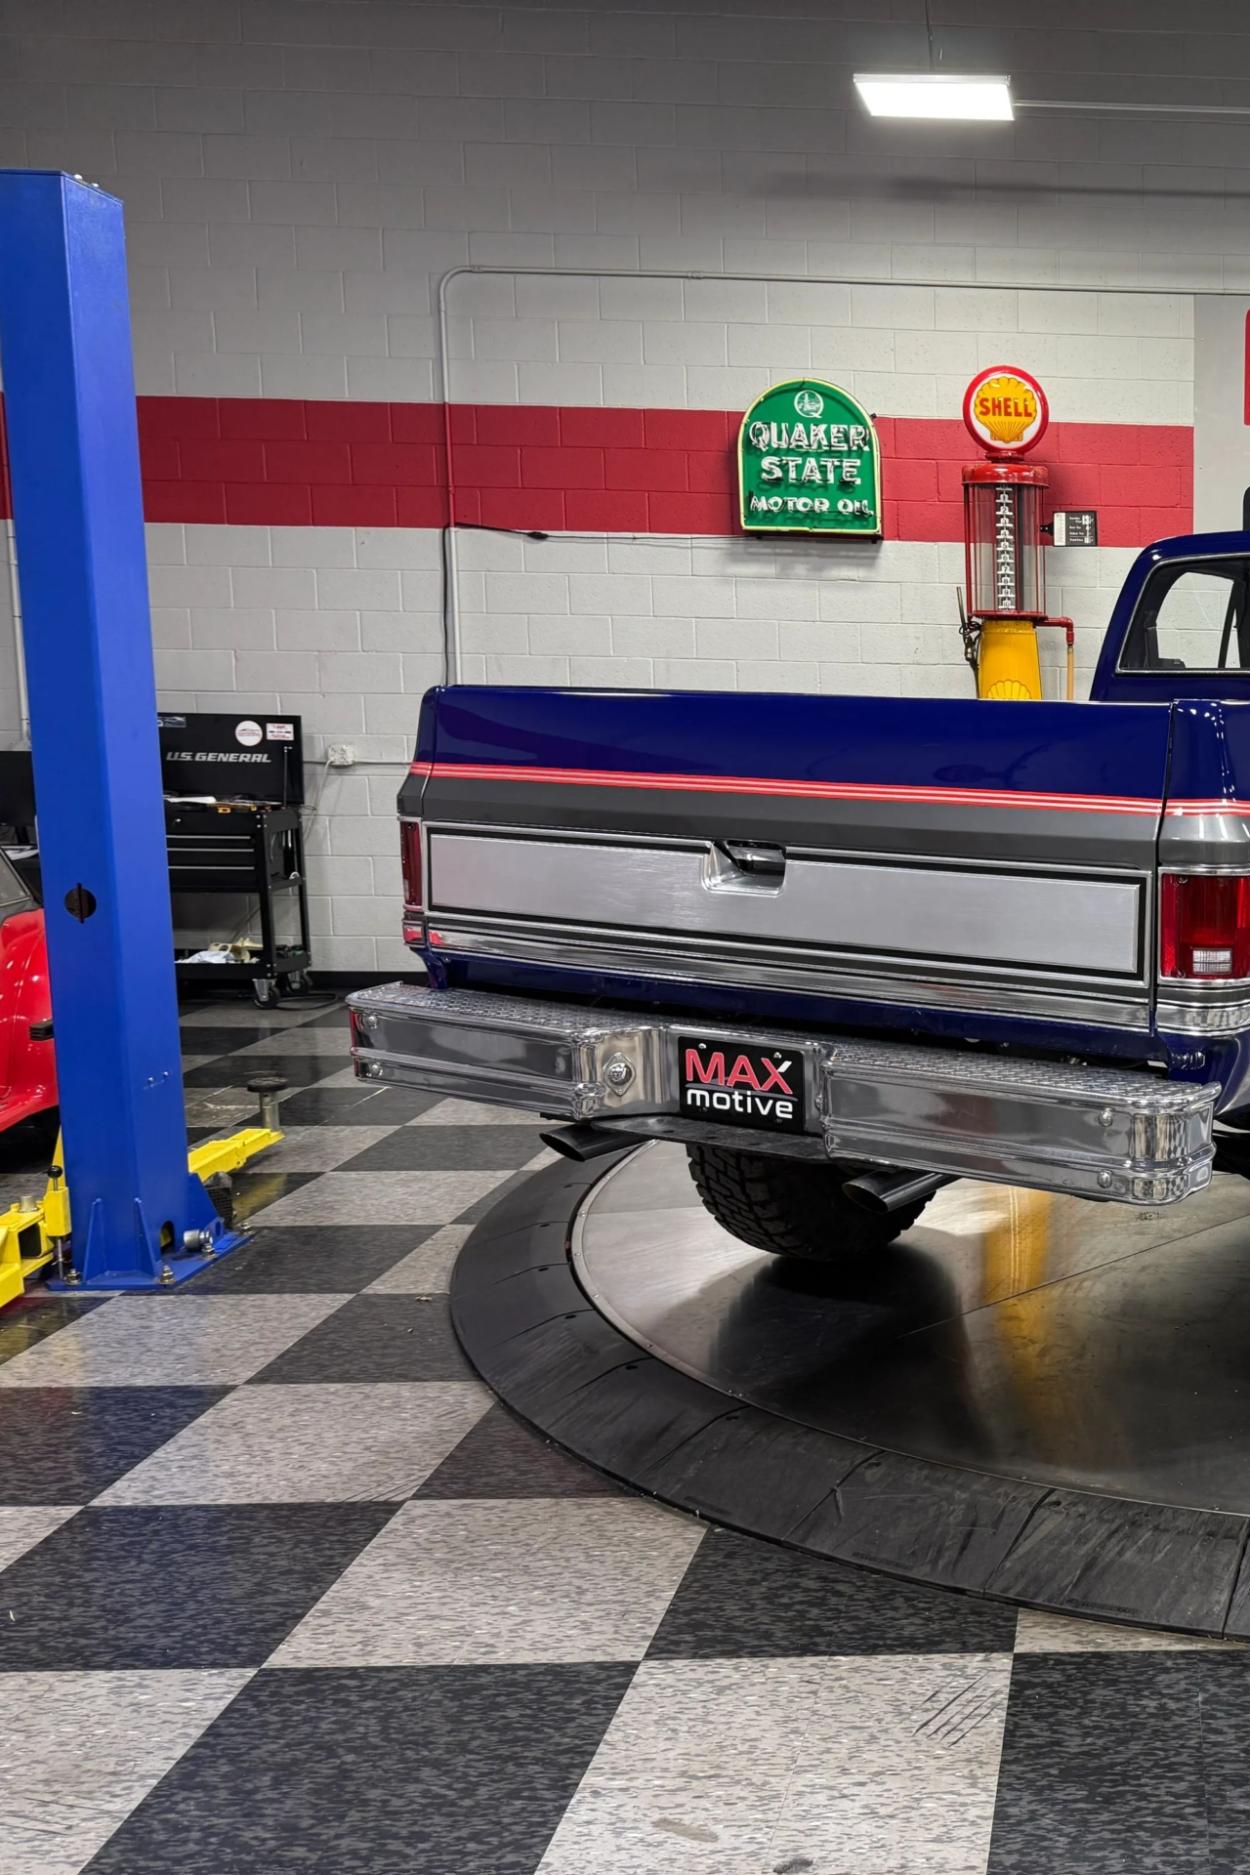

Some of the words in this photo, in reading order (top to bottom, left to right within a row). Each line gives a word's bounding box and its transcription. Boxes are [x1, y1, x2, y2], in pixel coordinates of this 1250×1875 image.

[979, 397, 1033, 418] SHELL
[749, 421, 870, 452] QUAKER
[761, 455, 861, 485] STATE
[750, 495, 830, 512] MOTOR
[837, 498, 874, 515] OIL
[195, 753, 272, 763] GENERAL
[685, 1048, 793, 1095] MAX
[687, 1089, 793, 1119] motive
